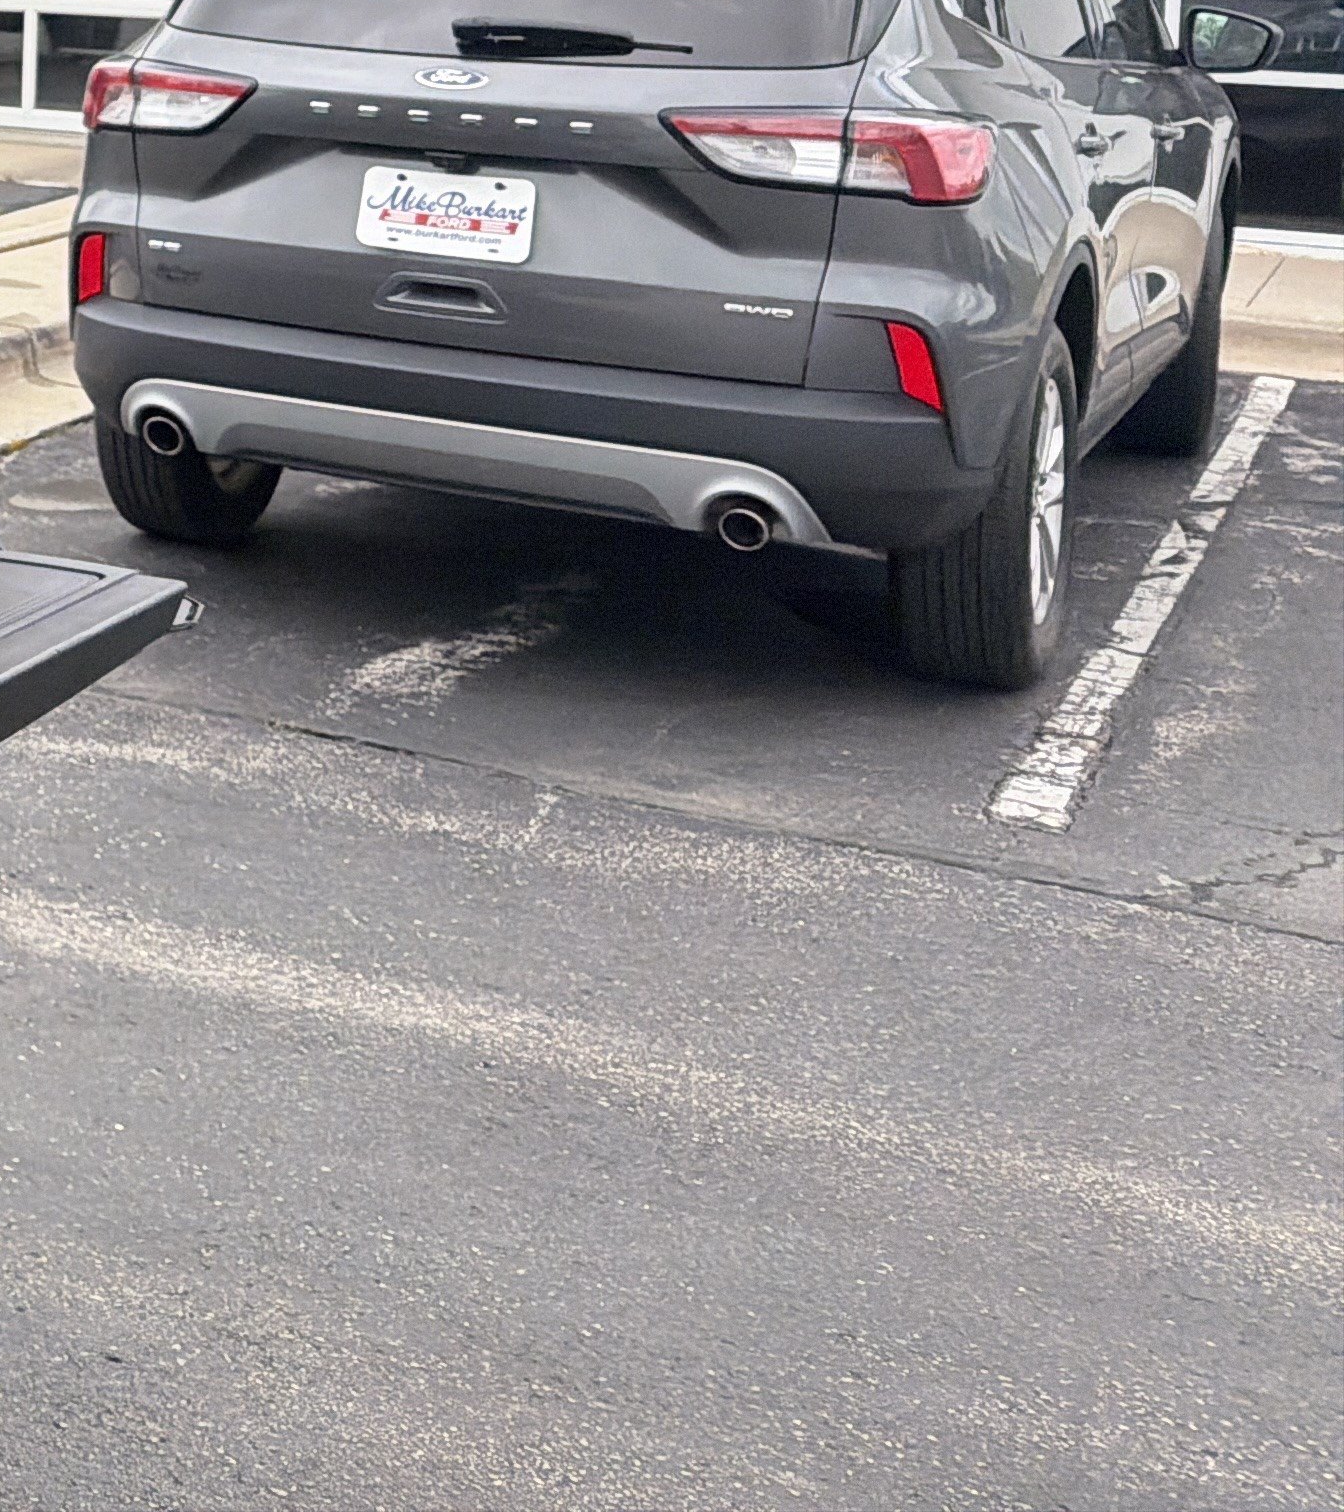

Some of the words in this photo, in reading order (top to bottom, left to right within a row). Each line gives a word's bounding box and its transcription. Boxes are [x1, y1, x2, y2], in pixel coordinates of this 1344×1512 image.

[367, 185, 438, 213] Mike
[436, 191, 528, 221] Burkart
[426, 215, 472, 230] FORD
